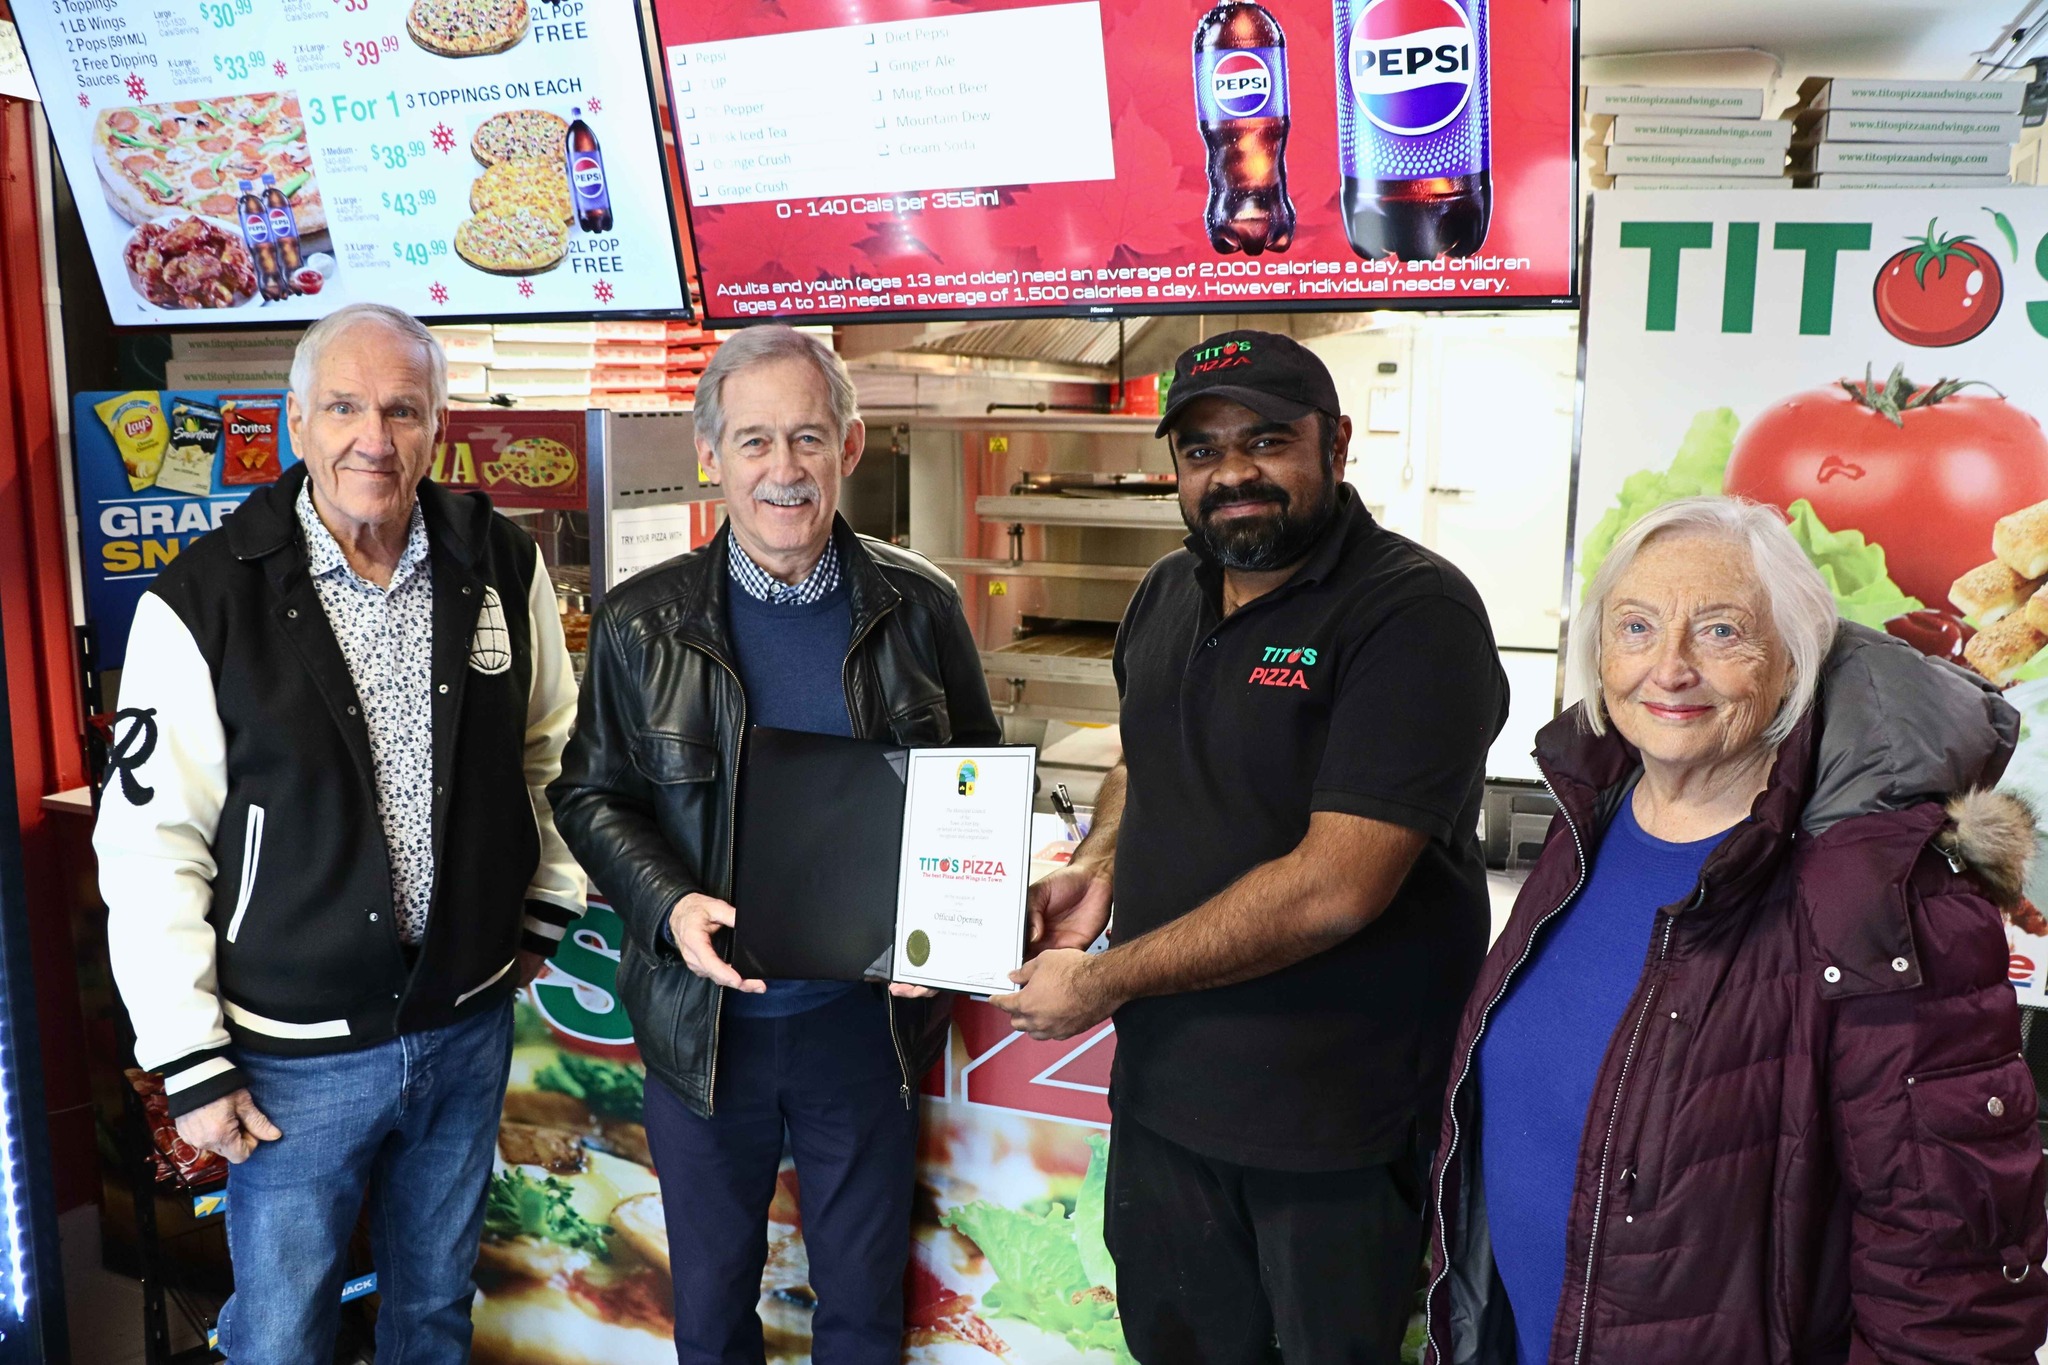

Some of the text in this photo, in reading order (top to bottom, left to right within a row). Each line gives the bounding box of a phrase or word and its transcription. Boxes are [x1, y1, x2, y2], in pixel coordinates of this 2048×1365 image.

[53, 0, 118, 14] 3 Toppings
[200, 0, 252, 28] $30.99
[530, 2, 584, 21] 2L POP
[60, 16, 127, 33] 1 LB Wings
[534, 21, 588, 43] FREE
[66, 32, 147, 52] 2 Pops (591ML)
[885, 28, 950, 44] Diet Pepsi
[342, 35, 400, 66] $39.99
[696, 52, 727, 65] Pepsi
[73, 52, 158, 72] 2 Free Dipping
[213, 50, 266, 80] $33.99
[888, 56, 956, 73] Ginger Ale
[1356, 43, 1470, 77] PEPSI
[77, 74, 121, 88] Sauces
[711, 77, 727, 90] UP
[1215, 76, 1267, 91] PEPSI
[405, 77, 583, 109] 3 TOPPINGS ON EACH
[892, 82, 989, 102] Mug Root Beer
[1605, 94, 1743, 107] www.titospizzaandwings.com
[1851, 88, 2003, 101] www.titospizzaandwings.com
[309, 90, 400, 125] 3 For 1
[724, 103, 766, 117] Pepper
[896, 111, 992, 128] Mountain Dew
[1849, 120, 2000, 134] www.titospizzaandwings.com
[740, 127, 788, 141] Iced Tea
[1634, 124, 1773, 138] www.titospizzaandwings.com
[370, 140, 426, 169] $38.99
[899, 143, 941, 155] Cream
[758, 153, 792, 166] Crush
[1626, 154, 1766, 166] www.titospizzaandwings.com
[1839, 152, 1988, 165] www.titospizzaandwings.com
[717, 180, 789, 198] Grape Crush
[381, 189, 437, 216] $43.99
[808, 199, 848, 217] 140
[851, 196, 894, 214] Cals
[897, 195, 928, 213] per
[931, 190, 1000, 209] 355ml
[392, 239, 448, 265] $49.99
[569, 238, 620, 254] 2L POP
[572, 256, 624, 274] FREE
[716, 255, 1531, 297] Adults and youth (ages 13 and older) need an average of 2,000 calories a day, and children
[733, 276, 1511, 315] (ages 4 to 12) need an average of 1,500 calories a day. However, individual needs vary.
[1190, 356, 1252, 377] PIZZA
[173, 427, 217, 441] Smartfood
[231, 423, 272, 435] Doritos
[621, 536, 634, 545] TRY
[1248, 667, 1310, 690] PIZZA
[102, 707, 158, 807] R
[962, 858, 1007, 876] PIZZA
[934, 912, 983, 926] Official Opening
